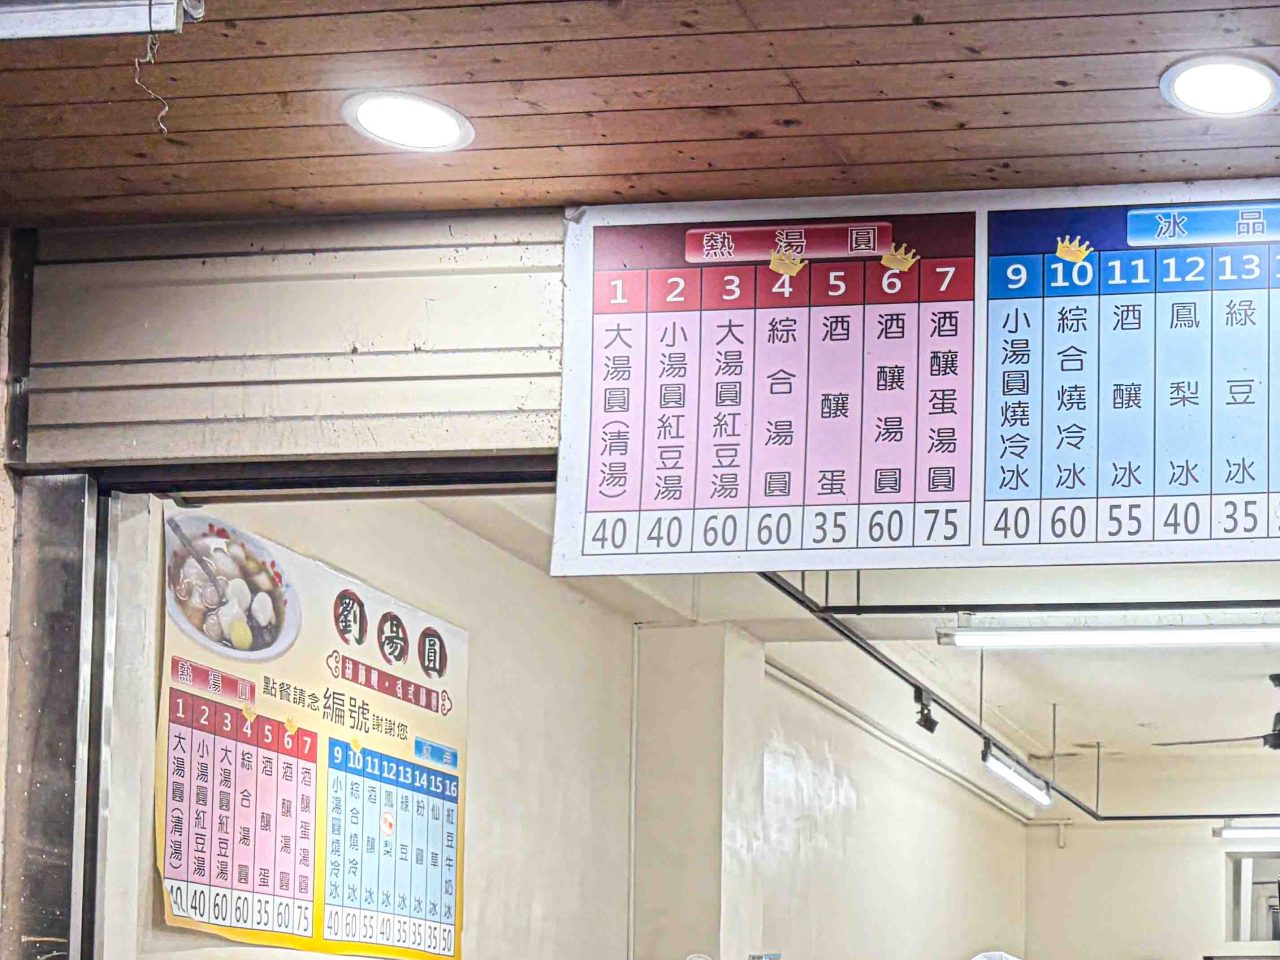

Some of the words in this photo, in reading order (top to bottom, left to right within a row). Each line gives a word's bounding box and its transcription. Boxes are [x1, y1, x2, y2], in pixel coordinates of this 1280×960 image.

[610, 279, 628, 304] 1
[666, 278, 684, 301] 2
[723, 276, 741, 299] 3
[772, 274, 792, 297] 4
[828, 272, 845, 295] 5
[882, 270, 901, 293] 6
[937, 267, 955, 291] 7
[703, 226, 878, 258] 熱湯圓
[1006, 265, 1027, 289] 9
[1050, 261, 1093, 287] 10
[1107, 259, 1150, 285] 11
[1162, 256, 1205, 283] 12
[1218, 254, 1262, 280] 13
[1155, 209, 1266, 239] 冰品
[654, 321, 687, 501] 小湯圓紅豆湯
[710, 319, 744, 498] 大湯圓紅豆湯
[764, 317, 797, 497] 綜合湯圓
[818, 315, 850, 496] 酒釀蛋
[874, 313, 906, 494] 酒釀湯圓
[928, 311, 959, 492] 酒釀蛋湯圓
[999, 308, 1031, 490] 小湯圓燒冷冰
[1056, 306, 1087, 489] 綜合燒冷冰
[1112, 304, 1142, 488] 酒釀冰
[1169, 302, 1201, 486] 鳳梨冰
[1225, 300, 1256, 485] 綠豆冰
[592, 519, 627, 549] 40
[648, 517, 682, 547] 40
[703, 515, 737, 546] 60
[758, 514, 792, 544] 60
[812, 511, 847, 543] 35
[868, 510, 902, 542] 60
[924, 509, 958, 541] 75
[993, 507, 1030, 538] 40
[1050, 506, 1087, 538] 60
[1107, 504, 1142, 537] 55
[1163, 503, 1200, 535] 40
[1223, 500, 1258, 533] 35
[176, 699, 185, 718] 1
[200, 705, 209, 725] 2
[222, 712, 232, 731] 3
[243, 720, 252, 737] 4
[264, 725, 272, 743] 5
[284, 732, 293, 748] 6
[303, 736, 311, 754] 7
[334, 748, 342, 763] 9
[347, 748, 363, 769] 10
[366, 754, 380, 774] 11
[382, 758, 396, 779] 12
[399, 763, 412, 784] 13
[415, 768, 428, 789] 14
[430, 773, 443, 793] 15
[444, 777, 457, 797] 16
[191, 889, 206, 917] 40
[213, 894, 228, 921] 60
[235, 896, 249, 924] 60
[257, 900, 270, 926] 35
[277, 903, 290, 929] 60
[297, 905, 309, 932] 75
[327, 909, 340, 936] 40
[345, 912, 357, 938] 60
[363, 914, 374, 940] 55
[379, 916, 391, 943] 40
[396, 919, 408, 944] 35
[411, 921, 423, 946] 35
[427, 924, 438, 950] 35
[442, 927, 452, 953] 50
